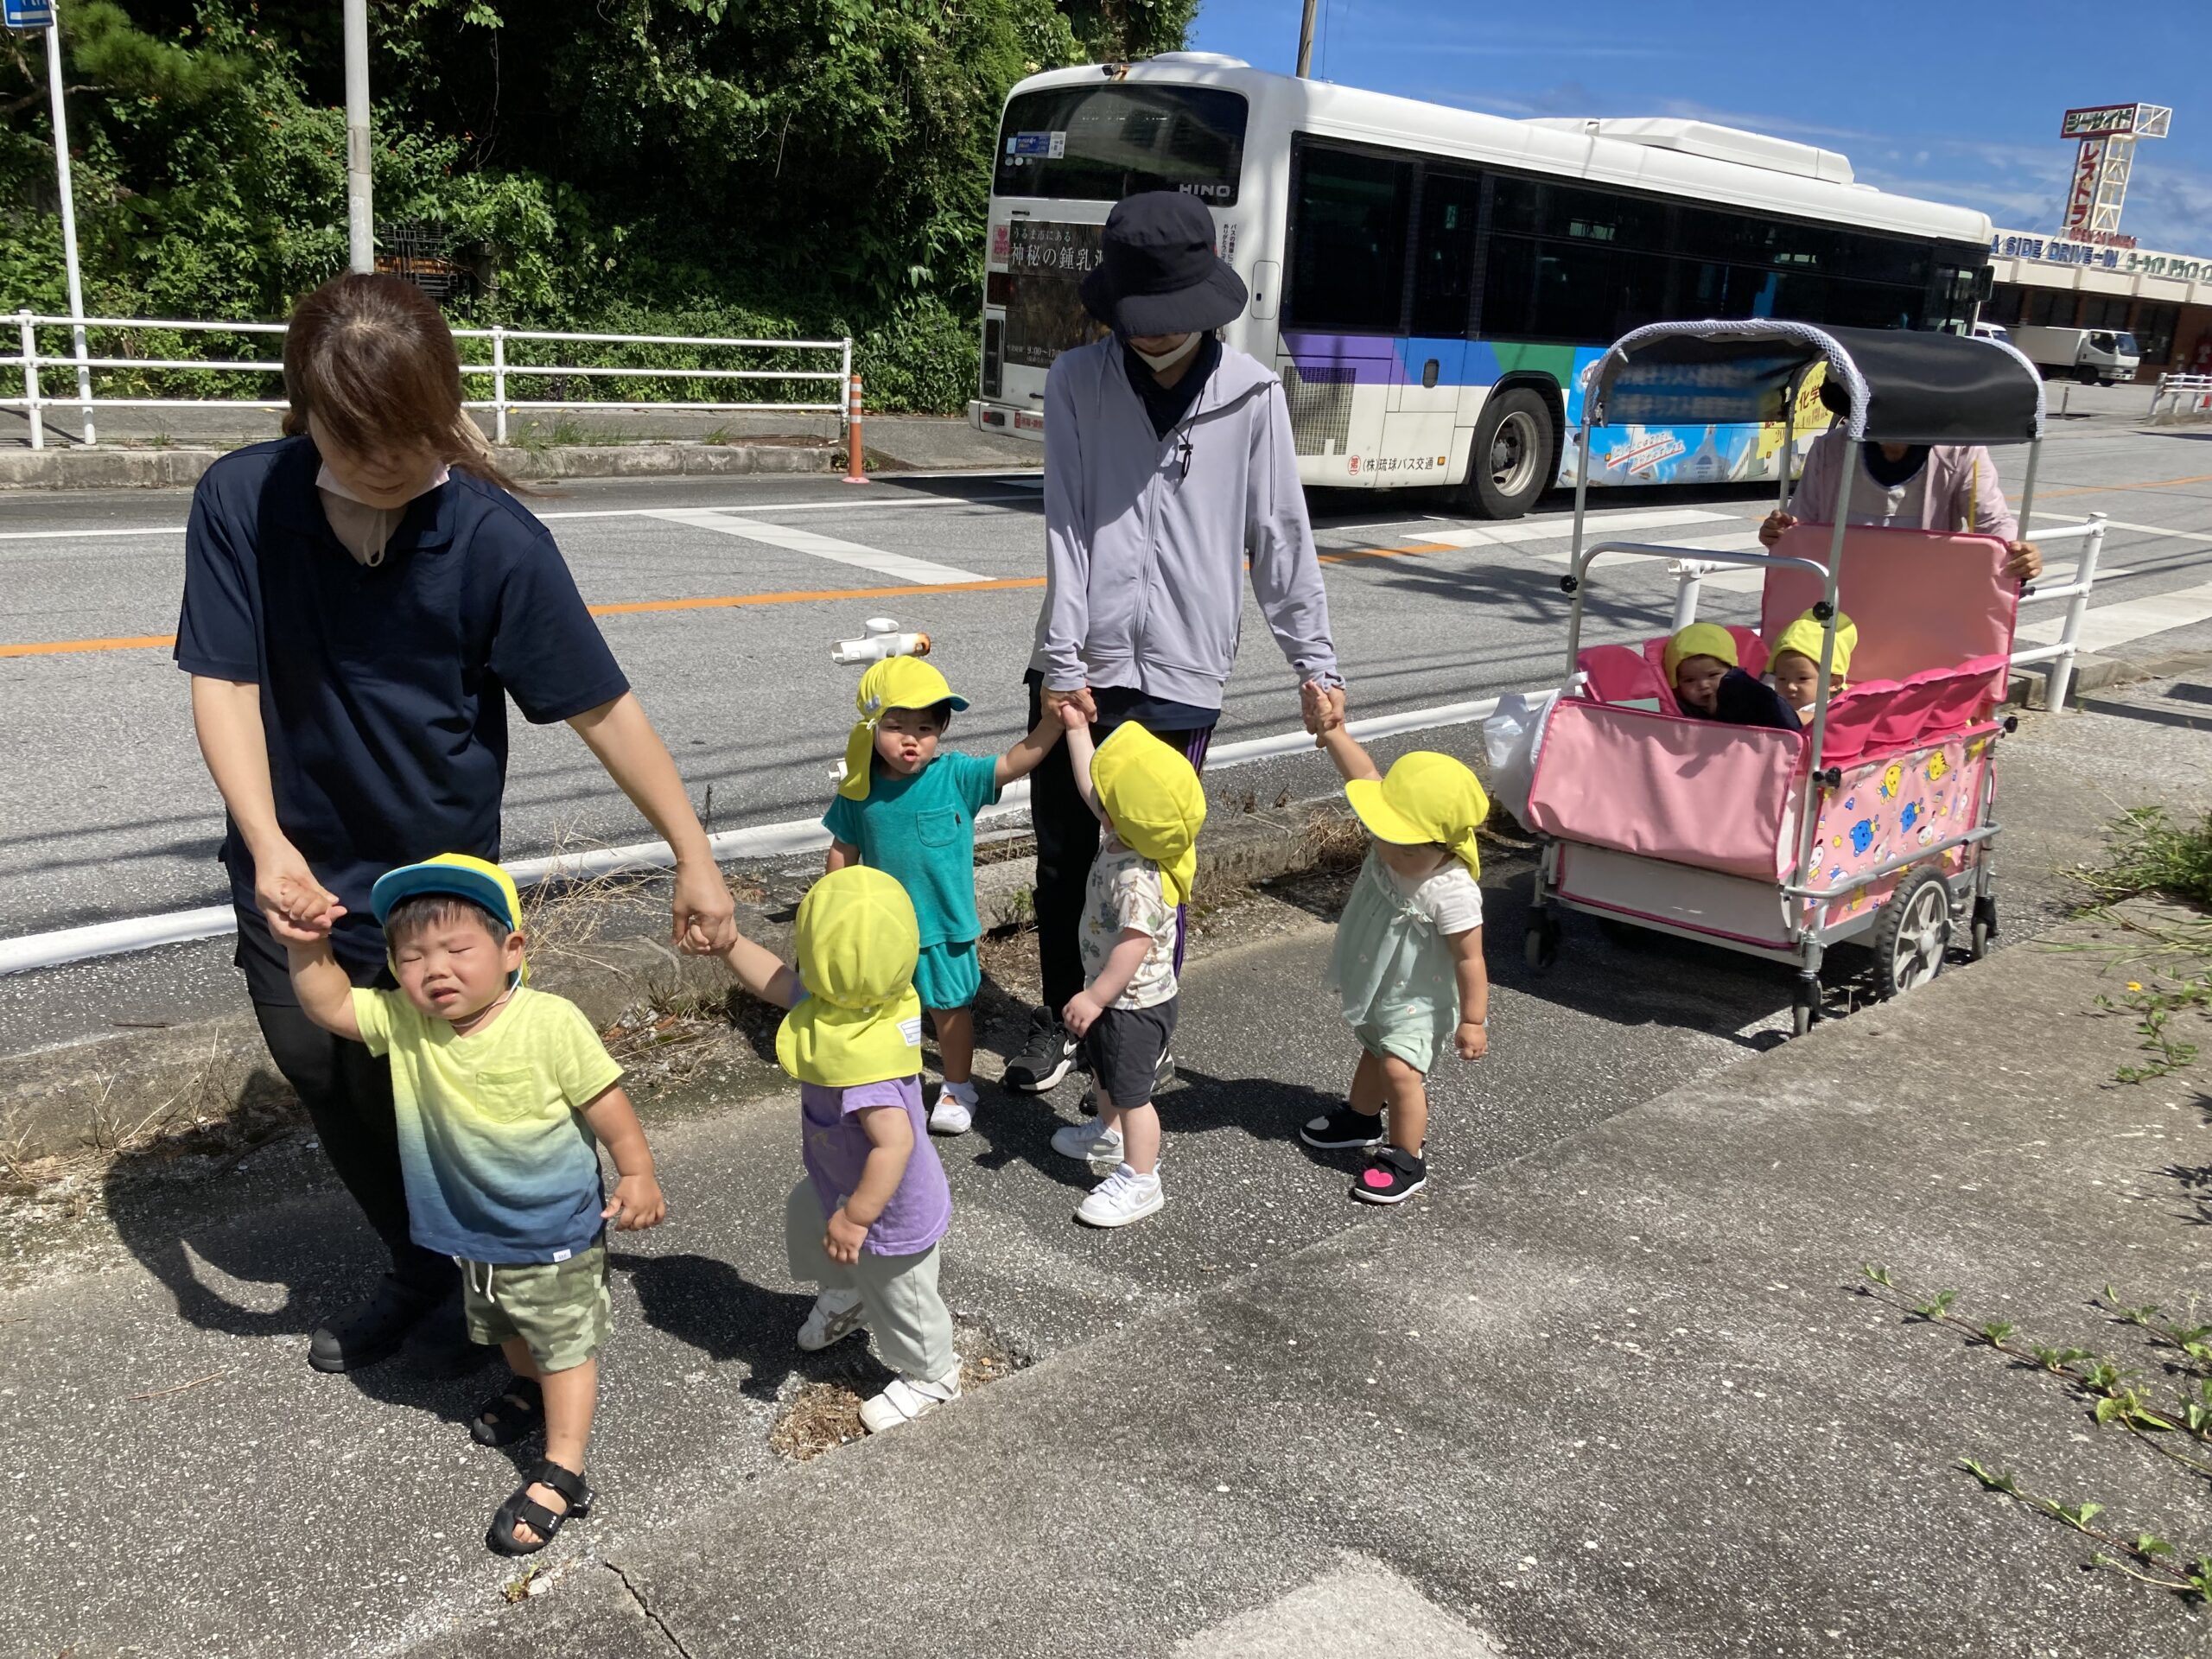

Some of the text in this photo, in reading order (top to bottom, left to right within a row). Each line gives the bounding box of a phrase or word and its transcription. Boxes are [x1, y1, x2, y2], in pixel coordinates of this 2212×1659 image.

[2066, 109, 2133, 132] シーサイド
[1179, 183, 1231, 198] HINO
[1014, 226, 1071, 243] うるま市にある
[2005, 236, 2044, 259] SIDE
[2048, 242, 2119, 269] DRIVE-IN
[1363, 456, 1433, 472] (株)琉球バス交通
